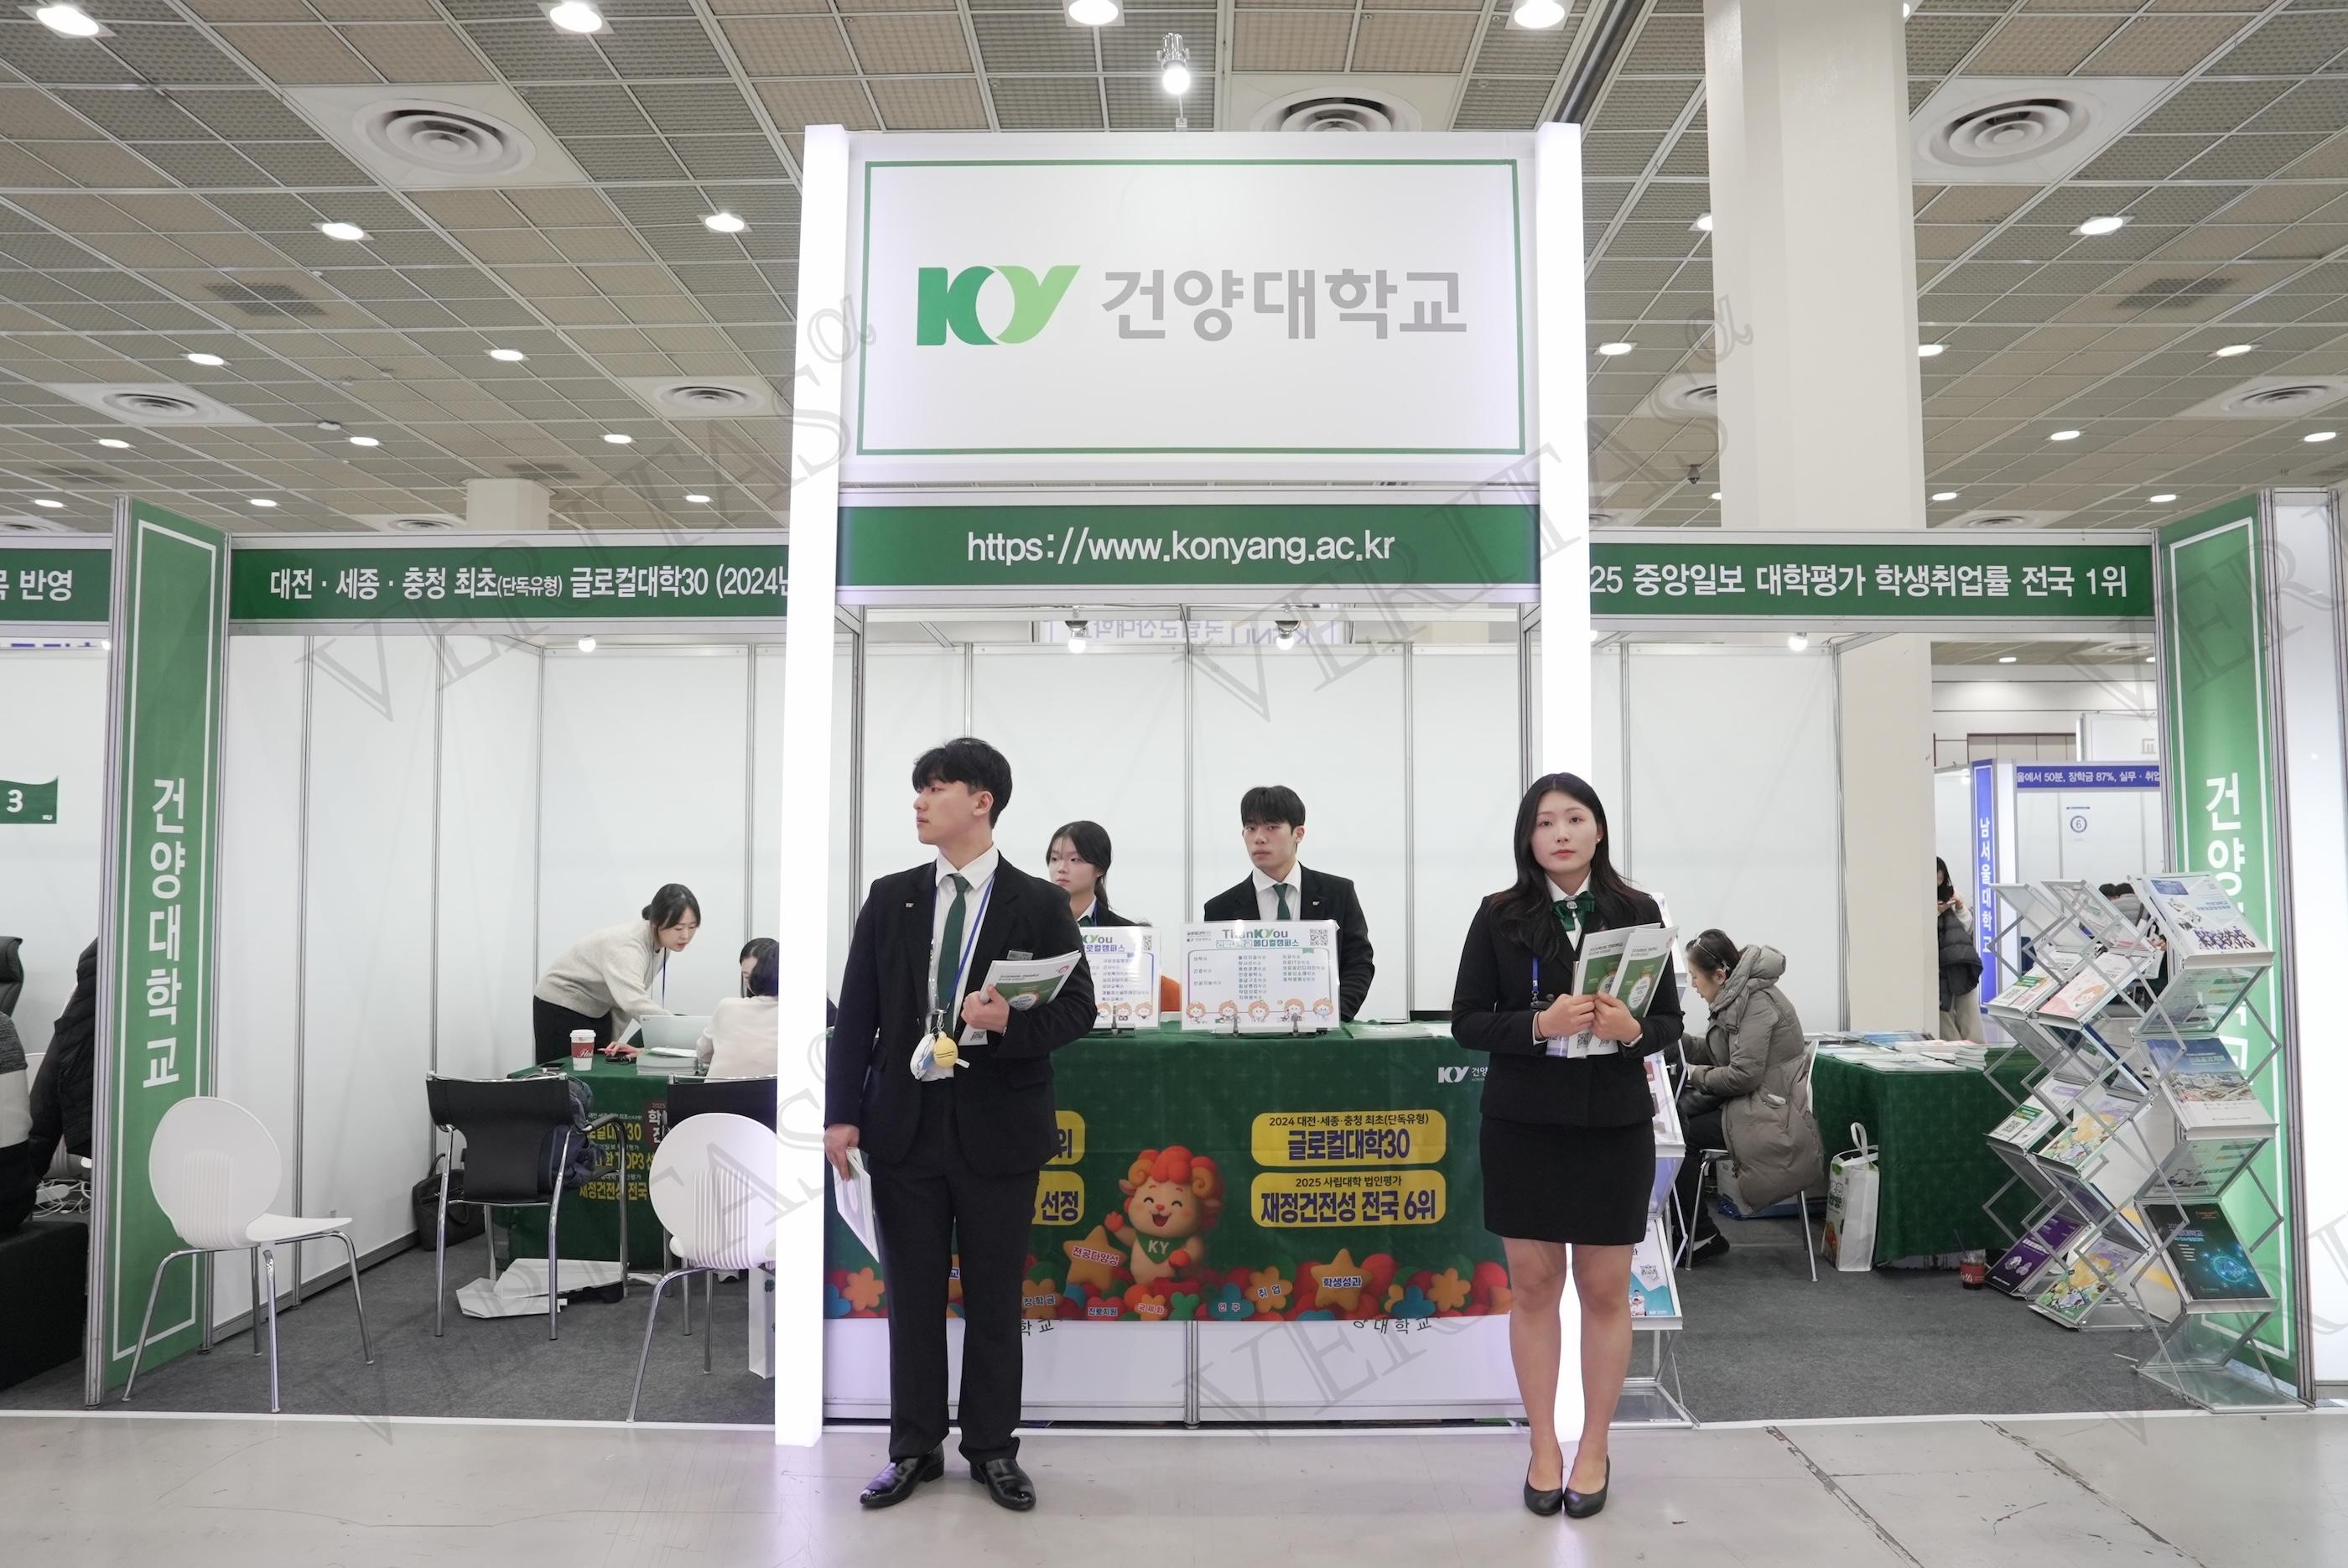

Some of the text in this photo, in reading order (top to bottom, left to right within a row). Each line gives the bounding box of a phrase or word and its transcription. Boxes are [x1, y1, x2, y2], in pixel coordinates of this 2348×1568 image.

[917, 266, 1467, 345] KY 건양대학교
[968, 527, 1395, 566] https://www.konyang.ac.kr
[19, 569, 73, 601] 반영
[270, 568, 313, 600] 대전
[335, 568, 380, 600] 세종
[403, 567, 446, 600] 충청
[569, 565, 709, 600] 글로컬대학30
[1632, 563, 1746, 596] 중앙일보
[1756, 563, 1866, 597] 대학평가
[1874, 563, 2011, 597] 학생취업률
[2021, 565, 2075, 597] 전국
[2086, 565, 2127, 598] 1위
[2068, 772, 2094, 782] 장학금
[2119, 771, 2137, 782] 실무
[6, 789, 23, 813] 3
[143, 776, 186, 1088] 건양대학교
[1270, 1118, 1295, 1127] 2024
[1288, 1128, 1410, 1160] 글로컬대학30
[1296, 1175, 1402, 1187] 2025 사립대학 법인평가
[1042, 1191, 1078, 1222] 선정
[1260, 1189, 1436, 1223] 재정건전성 전국 6위
[1148, 1239, 1170, 1254] KY
[1322, 1275, 1363, 1288] 학생성과
